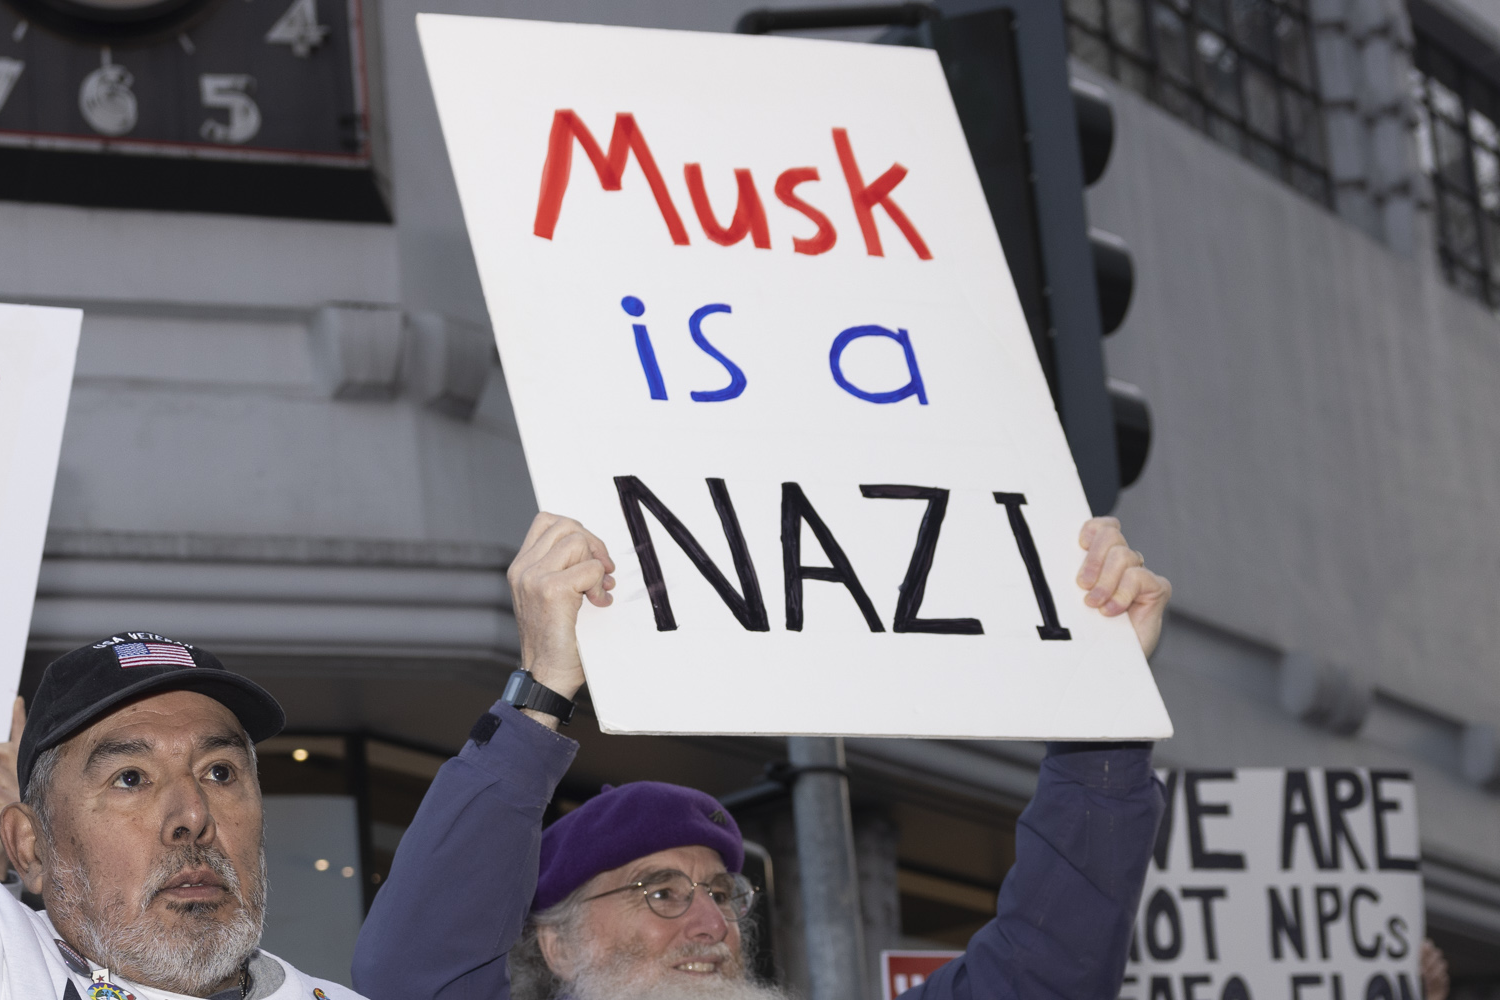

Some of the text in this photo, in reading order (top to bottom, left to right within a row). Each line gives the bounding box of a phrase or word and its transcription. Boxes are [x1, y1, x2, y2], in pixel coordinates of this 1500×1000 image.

[79, 65, 138, 136] 6
[200, 74, 261, 143] 5
[533, 109, 933, 260] Musk
[621, 296, 929, 405] is a
[613, 475, 1072, 641] NAZI
[1281, 769, 1421, 871] ARE
[1130, 886, 1227, 962] OT
